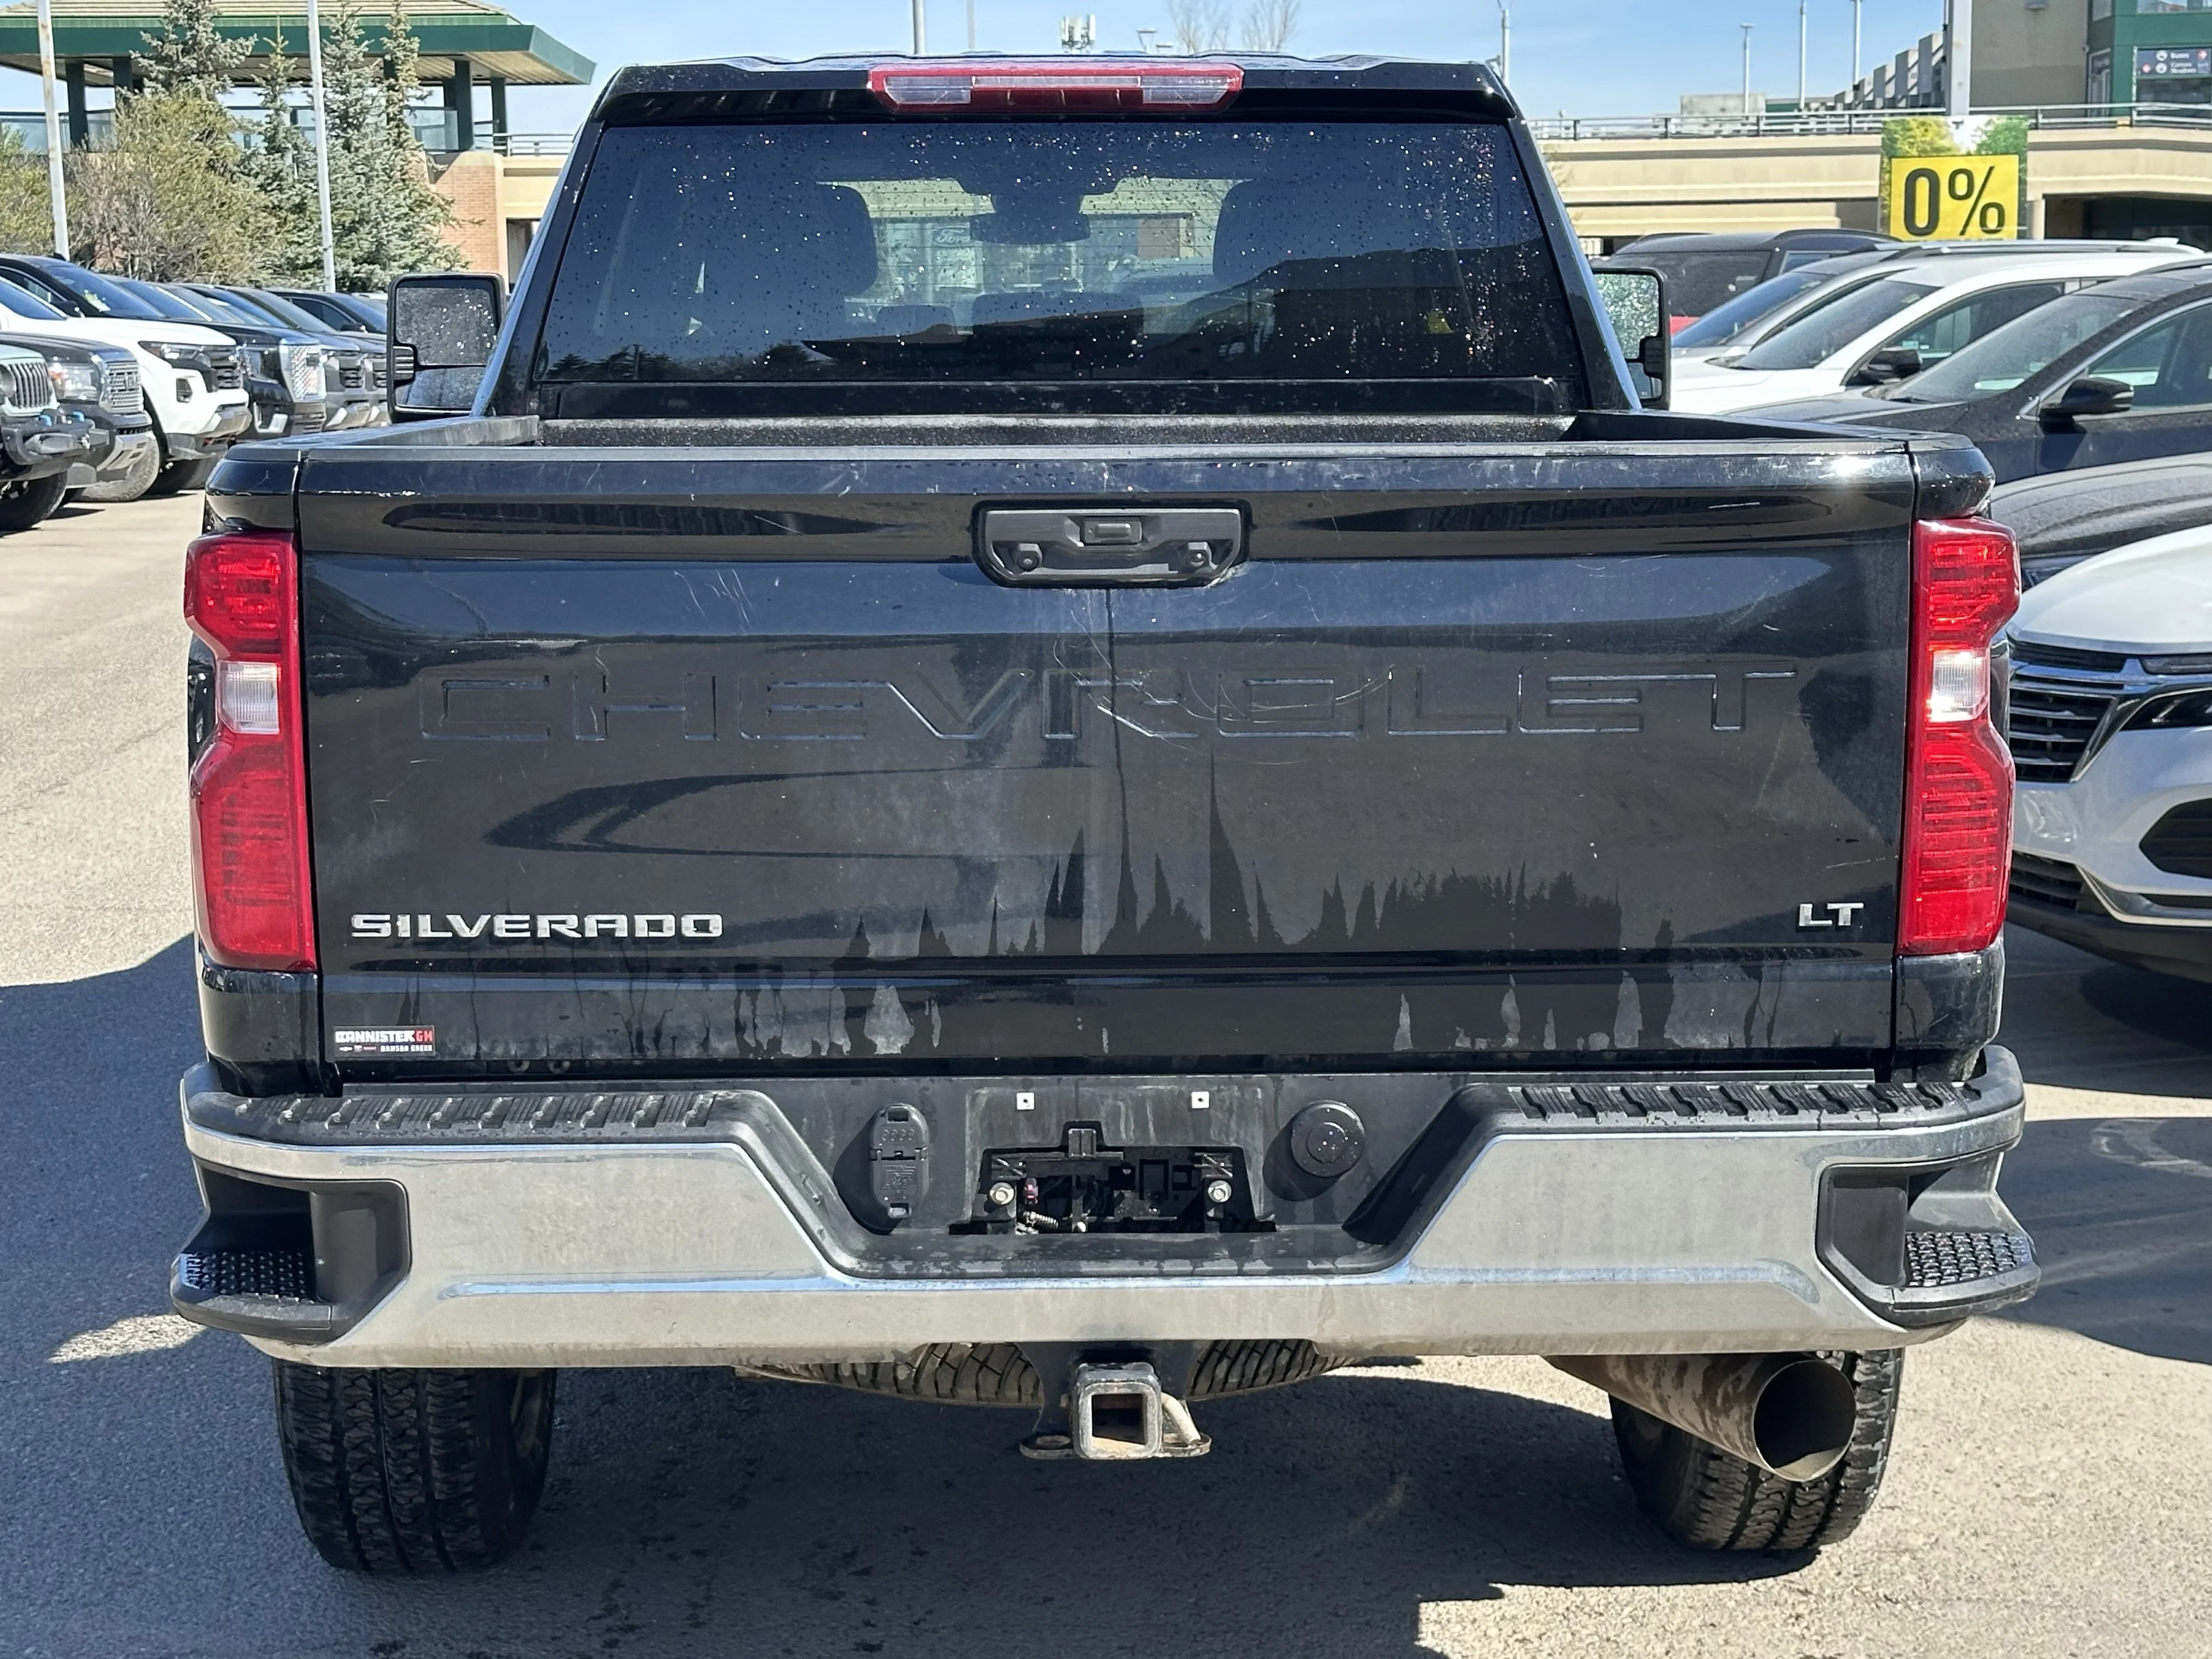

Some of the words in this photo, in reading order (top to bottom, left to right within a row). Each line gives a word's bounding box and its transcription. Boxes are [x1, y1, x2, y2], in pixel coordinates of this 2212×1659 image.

[1904, 166, 2006, 236] 0%
[419, 662, 1799, 742] CHEVROLET
[351, 913, 724, 938] SILVERADO
[1798, 902, 1864, 927] LT
